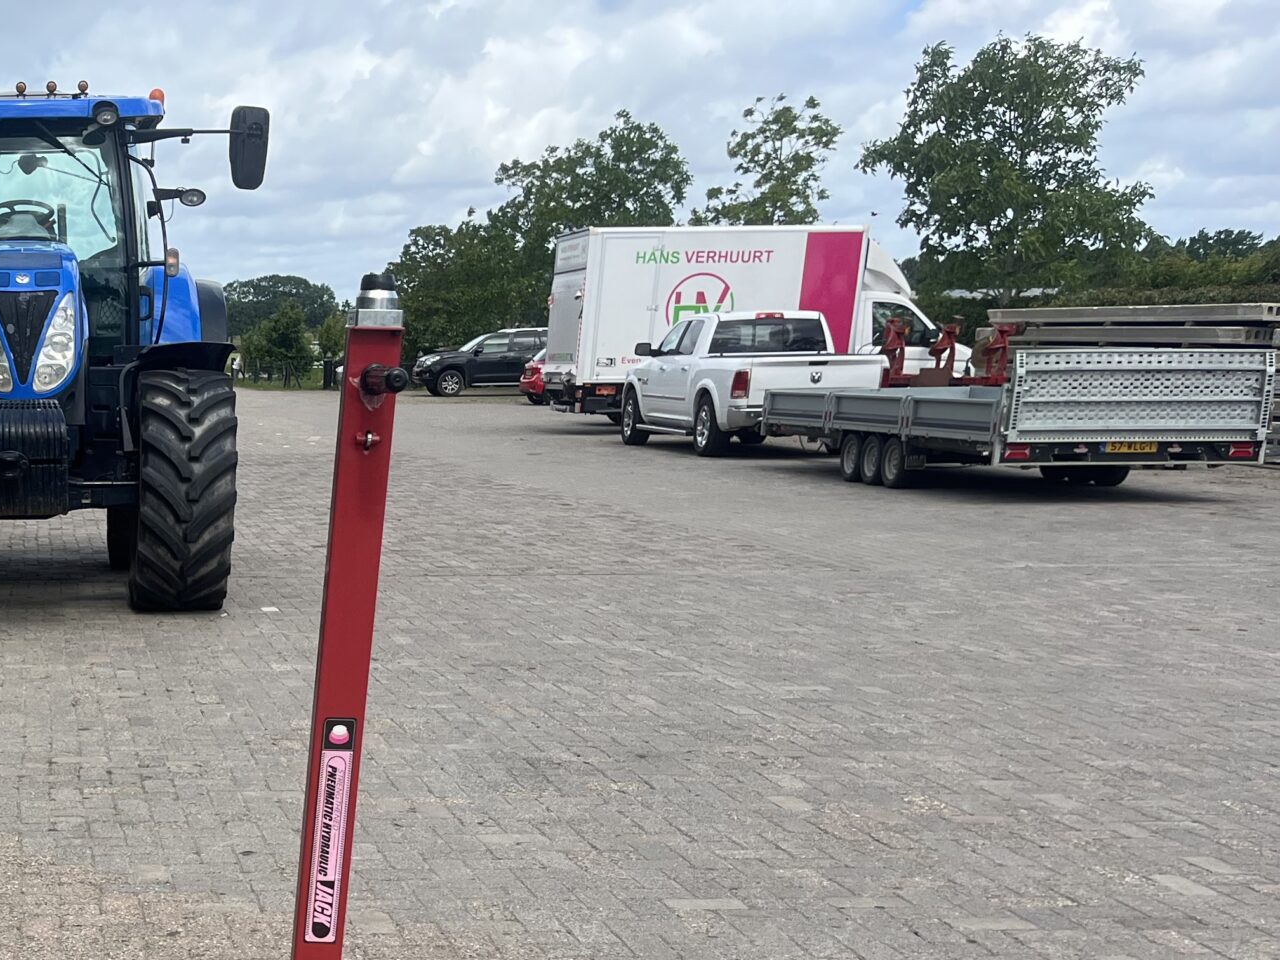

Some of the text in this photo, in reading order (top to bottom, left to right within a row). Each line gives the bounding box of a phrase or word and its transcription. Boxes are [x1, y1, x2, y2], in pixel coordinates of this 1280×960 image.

[635, 250, 774, 264] HANS VERHUURT
[318, 765, 337, 877] PNEUMATIC HYDRAULIC
[333, 769, 343, 831] STRENGTHENED
[313, 881, 334, 927] JACK
